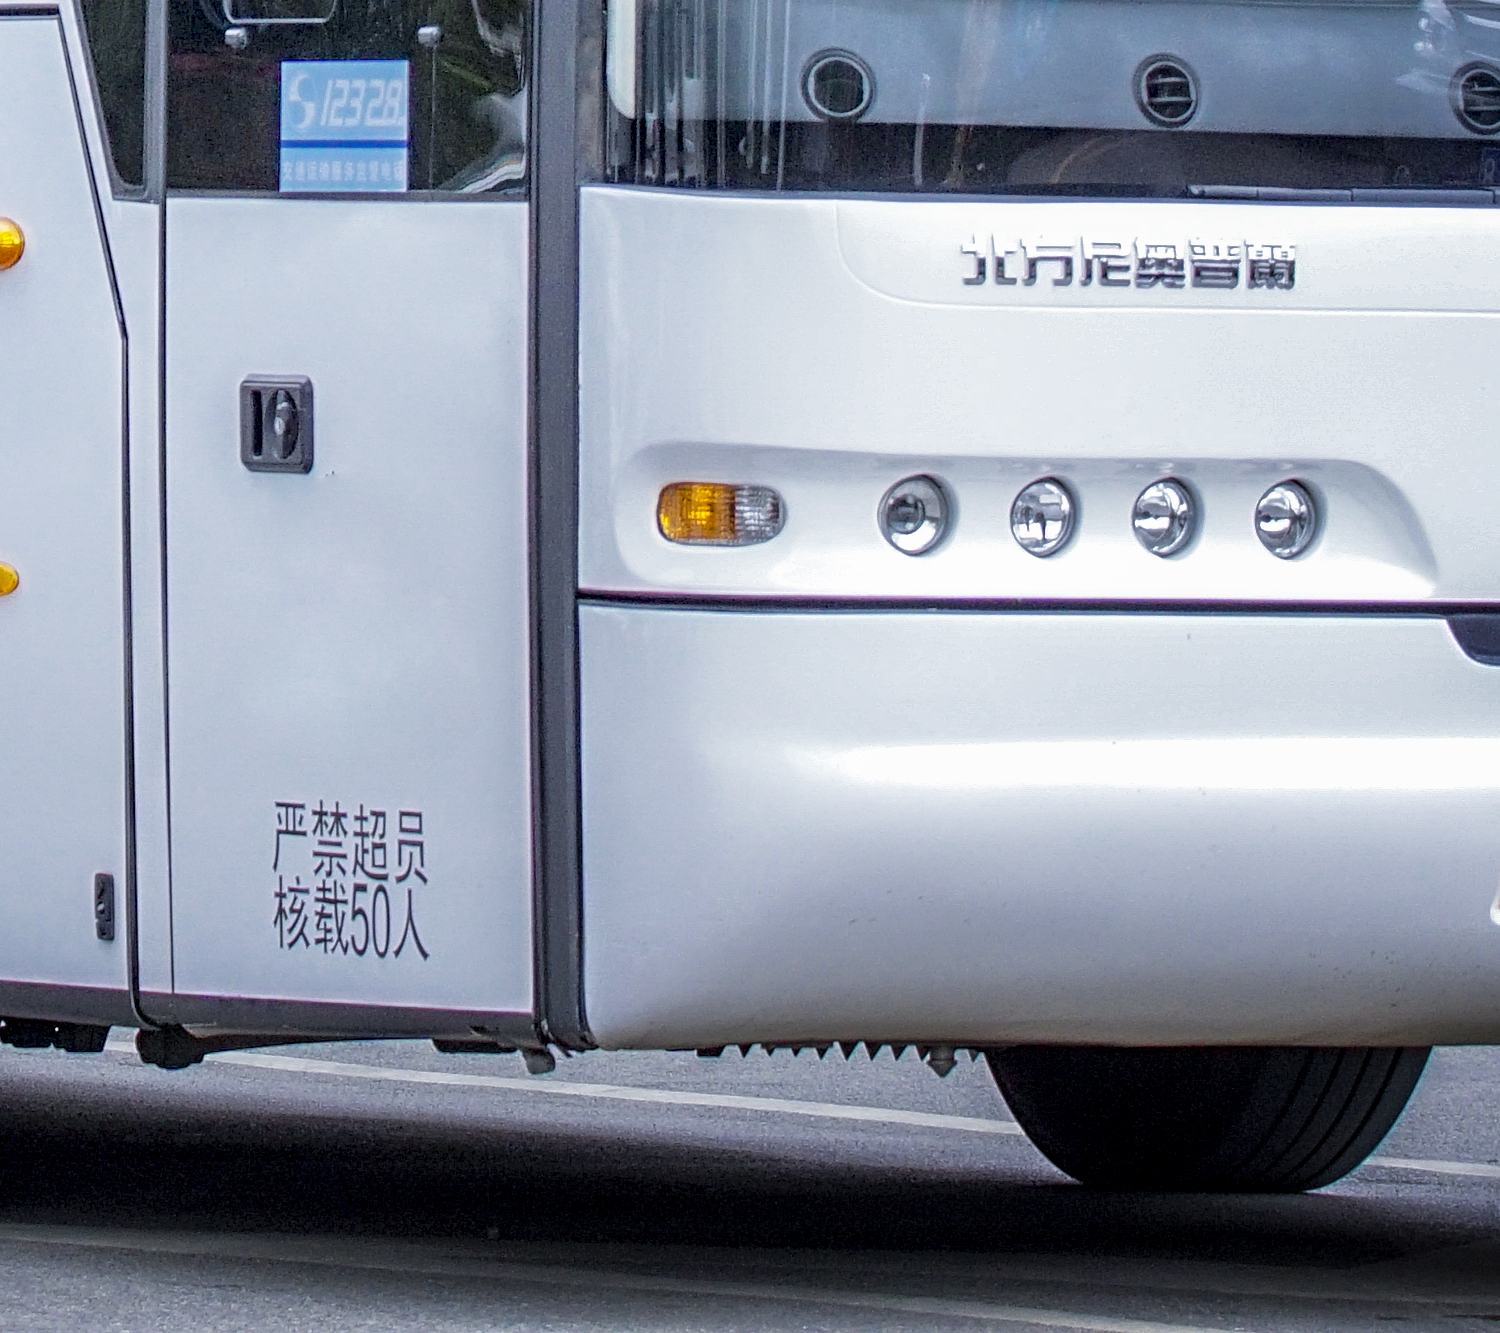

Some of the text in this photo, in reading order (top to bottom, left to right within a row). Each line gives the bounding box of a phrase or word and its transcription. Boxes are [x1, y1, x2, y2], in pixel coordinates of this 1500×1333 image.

[319, 78, 404, 128] 12328
[272, 799, 428, 885] 严禁超员
[272, 874, 430, 961] 核载50人
